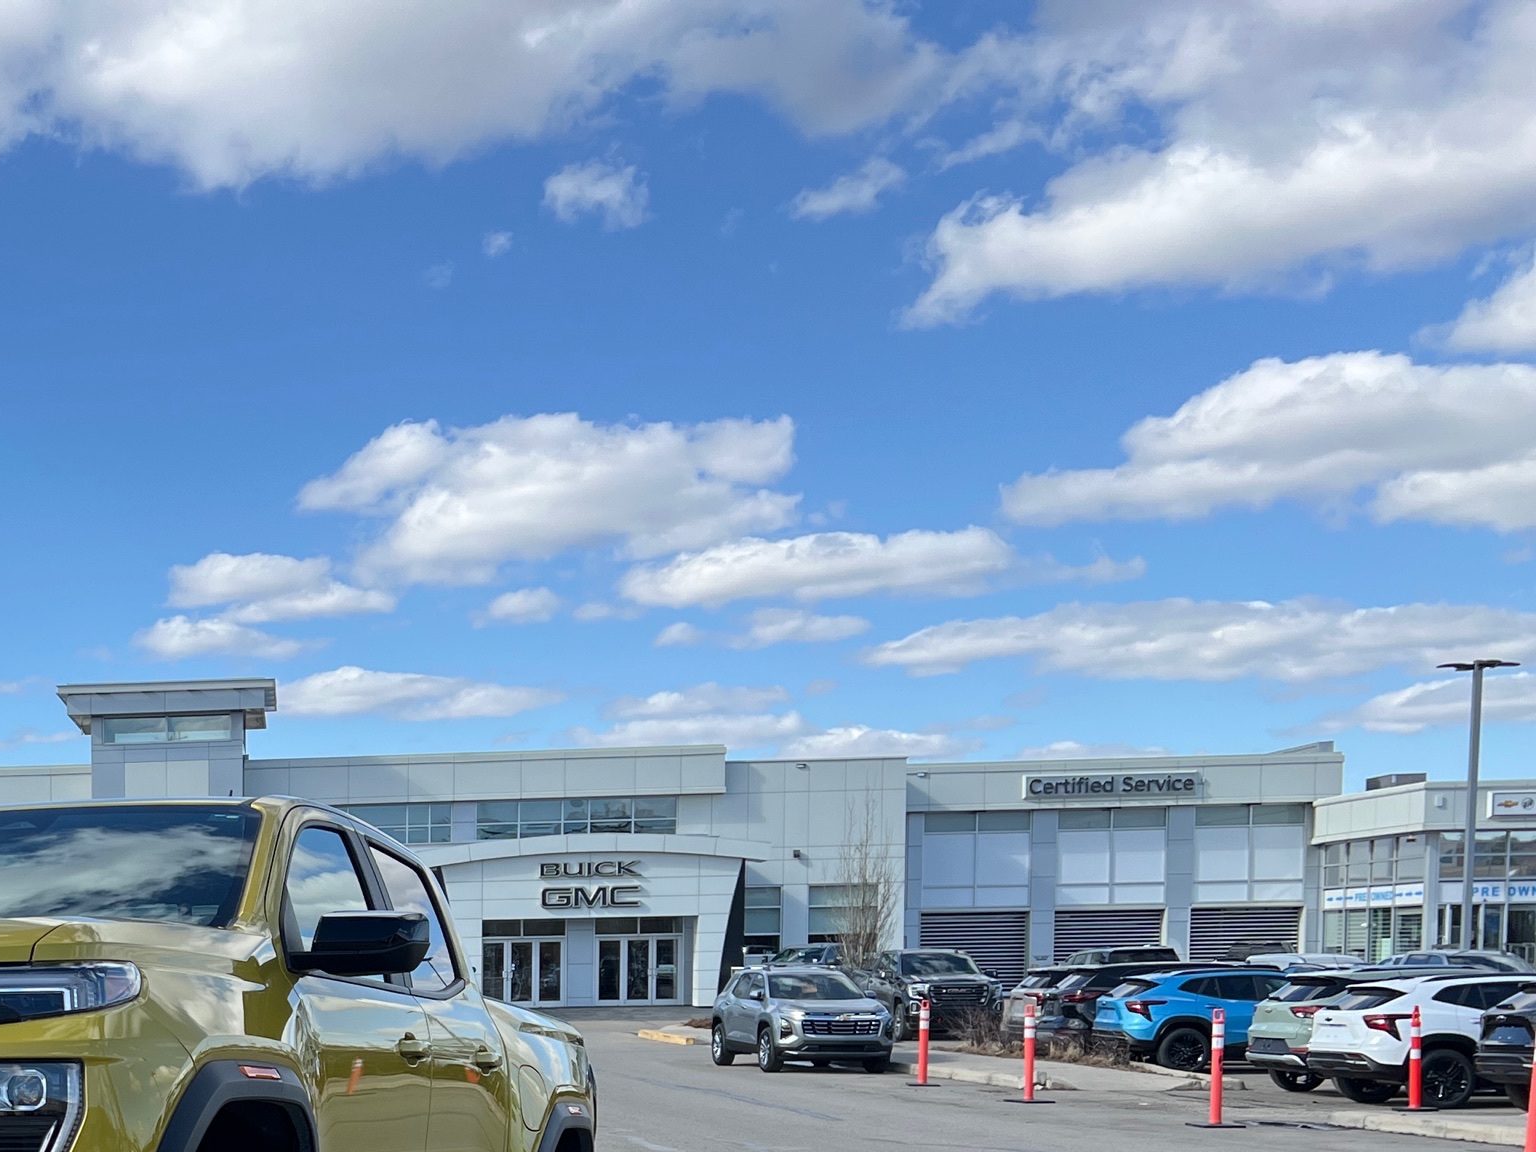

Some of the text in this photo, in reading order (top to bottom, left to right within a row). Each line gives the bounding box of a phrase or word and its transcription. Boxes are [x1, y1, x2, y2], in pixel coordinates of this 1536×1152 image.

[1028, 774, 1195, 795] Certified Service
[539, 859, 642, 878] BUICK
[540, 884, 641, 909] GMC
[1354, 893, 1367, 902] PRE
[1472, 886, 1500, 897] PRE
